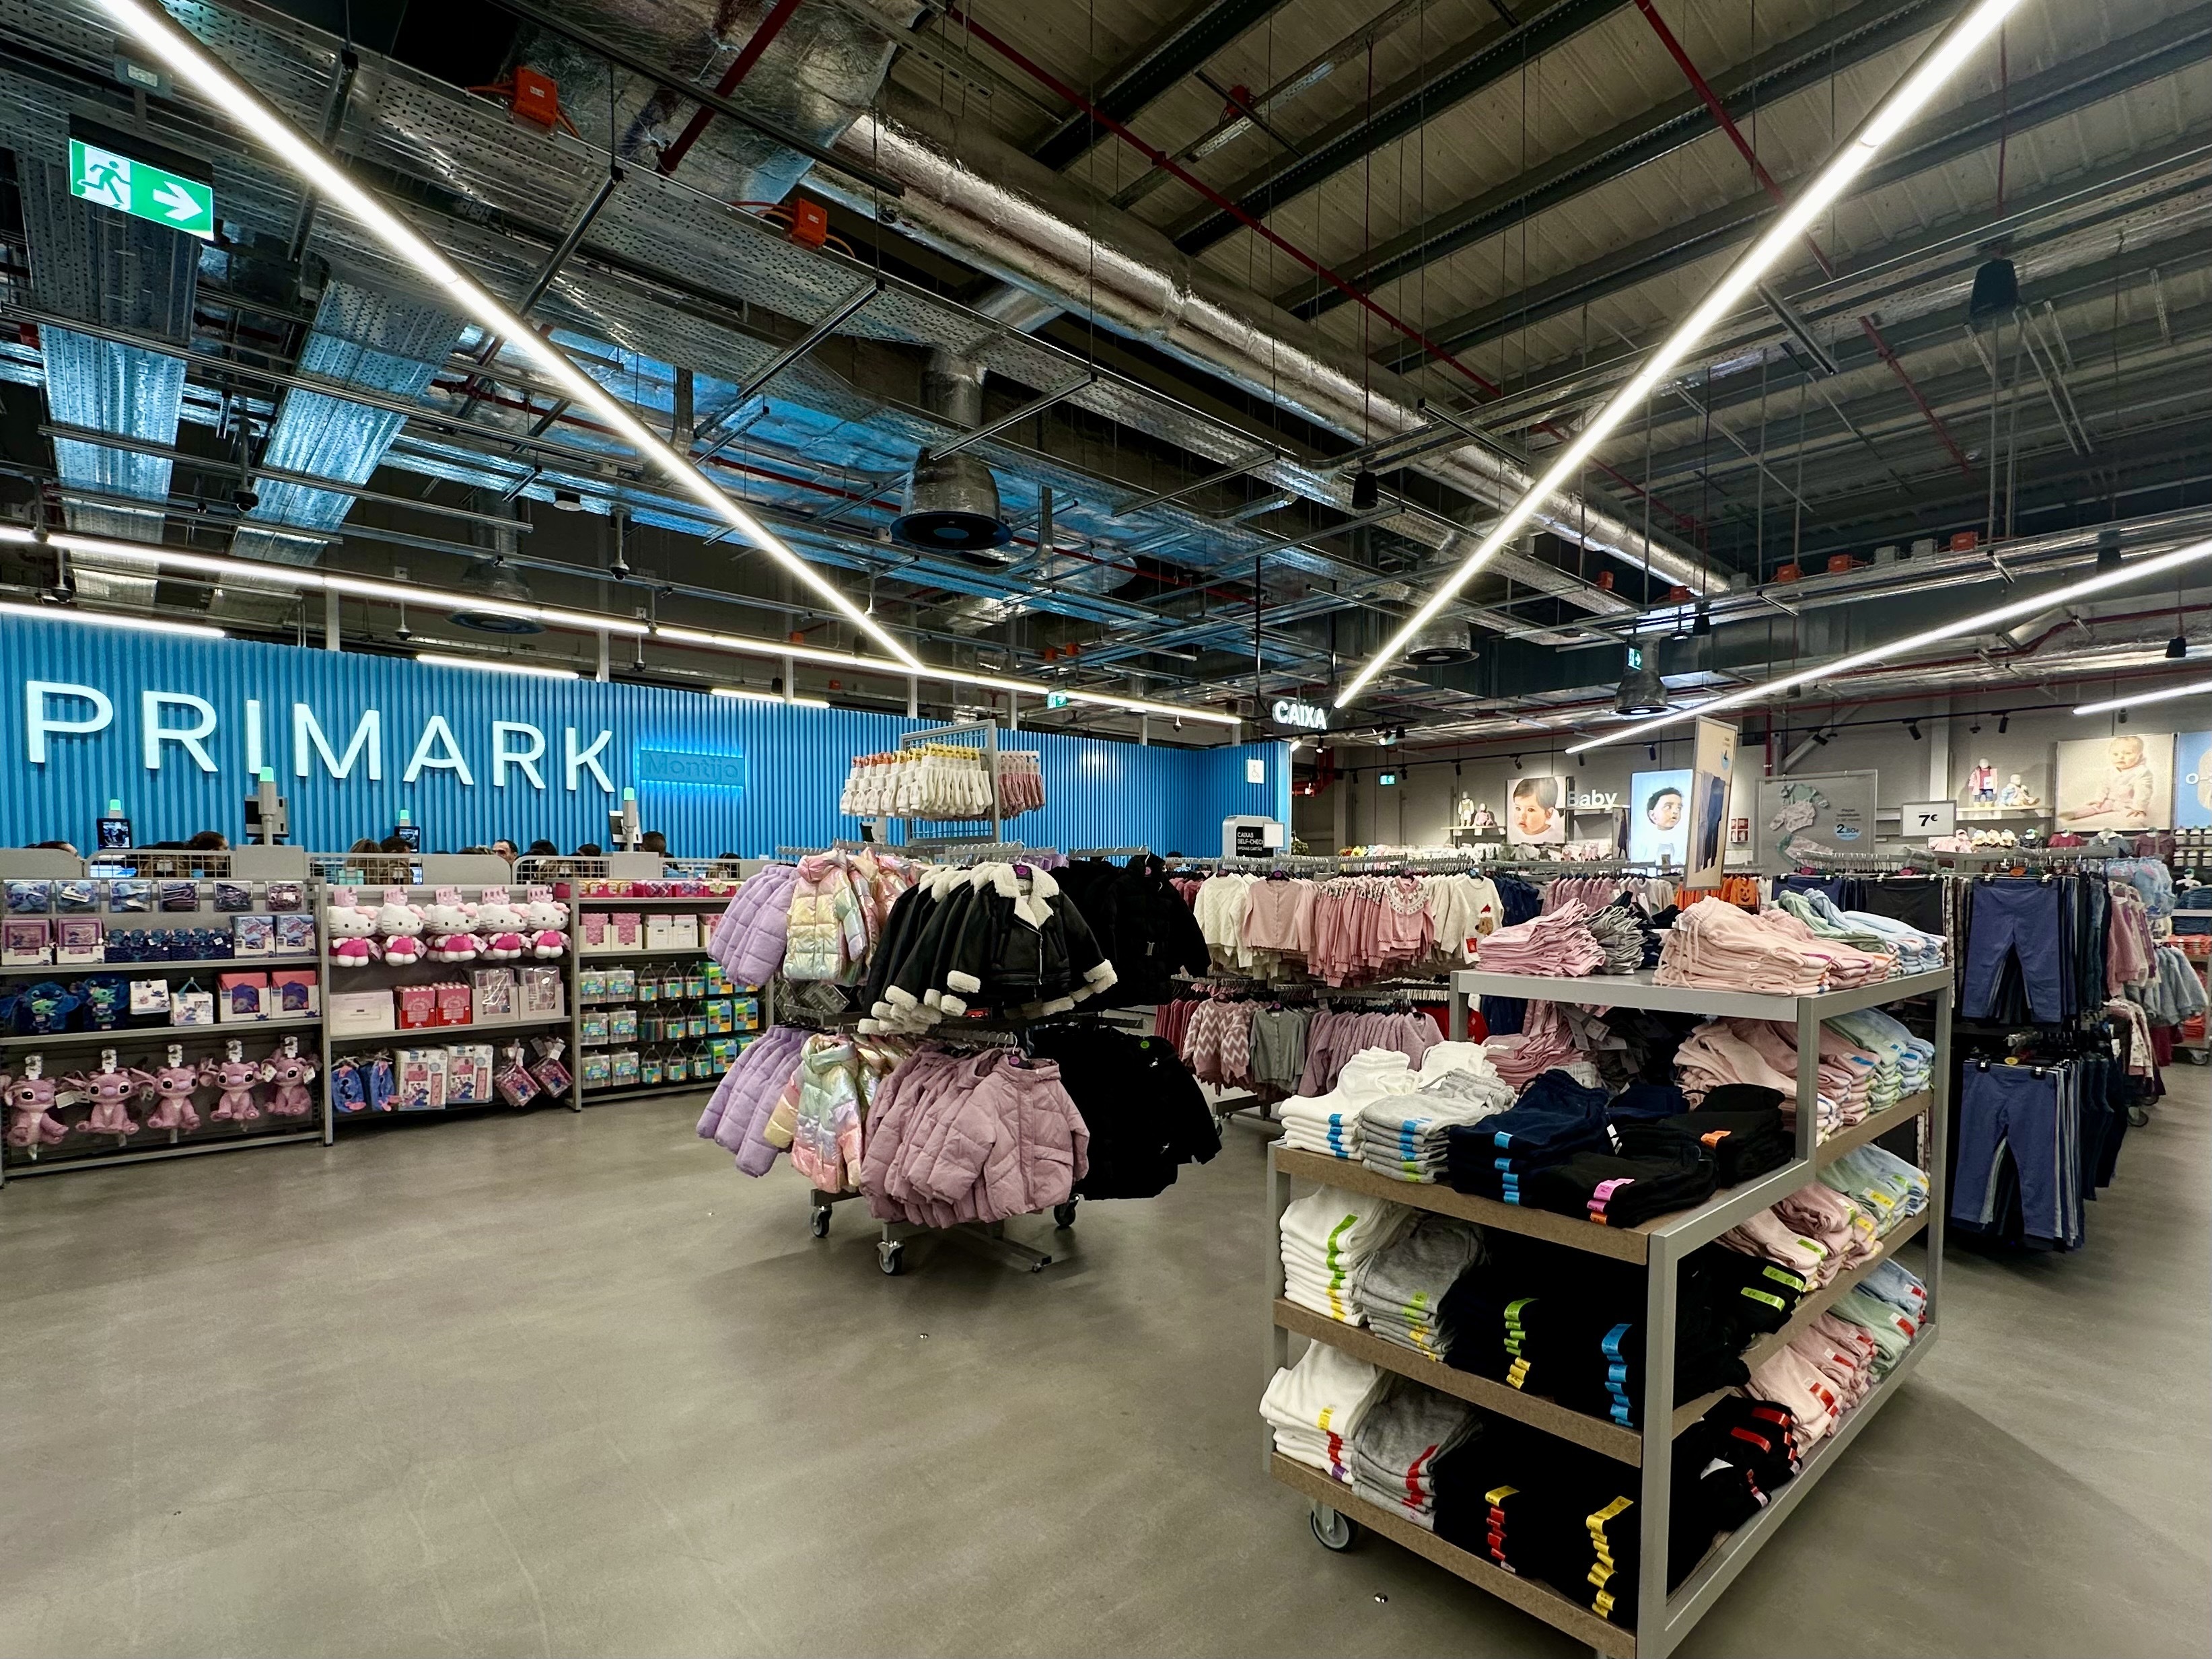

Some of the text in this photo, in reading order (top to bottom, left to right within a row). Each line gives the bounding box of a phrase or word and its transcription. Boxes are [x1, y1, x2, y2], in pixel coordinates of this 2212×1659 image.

[1273, 701, 1328, 730] CAIXA
[27, 680, 615, 793] PRIMARK
[643, 753, 739, 783] Montijo
[1566, 789, 1618, 811] Baby
[1918, 814, 1938, 826] 7€
